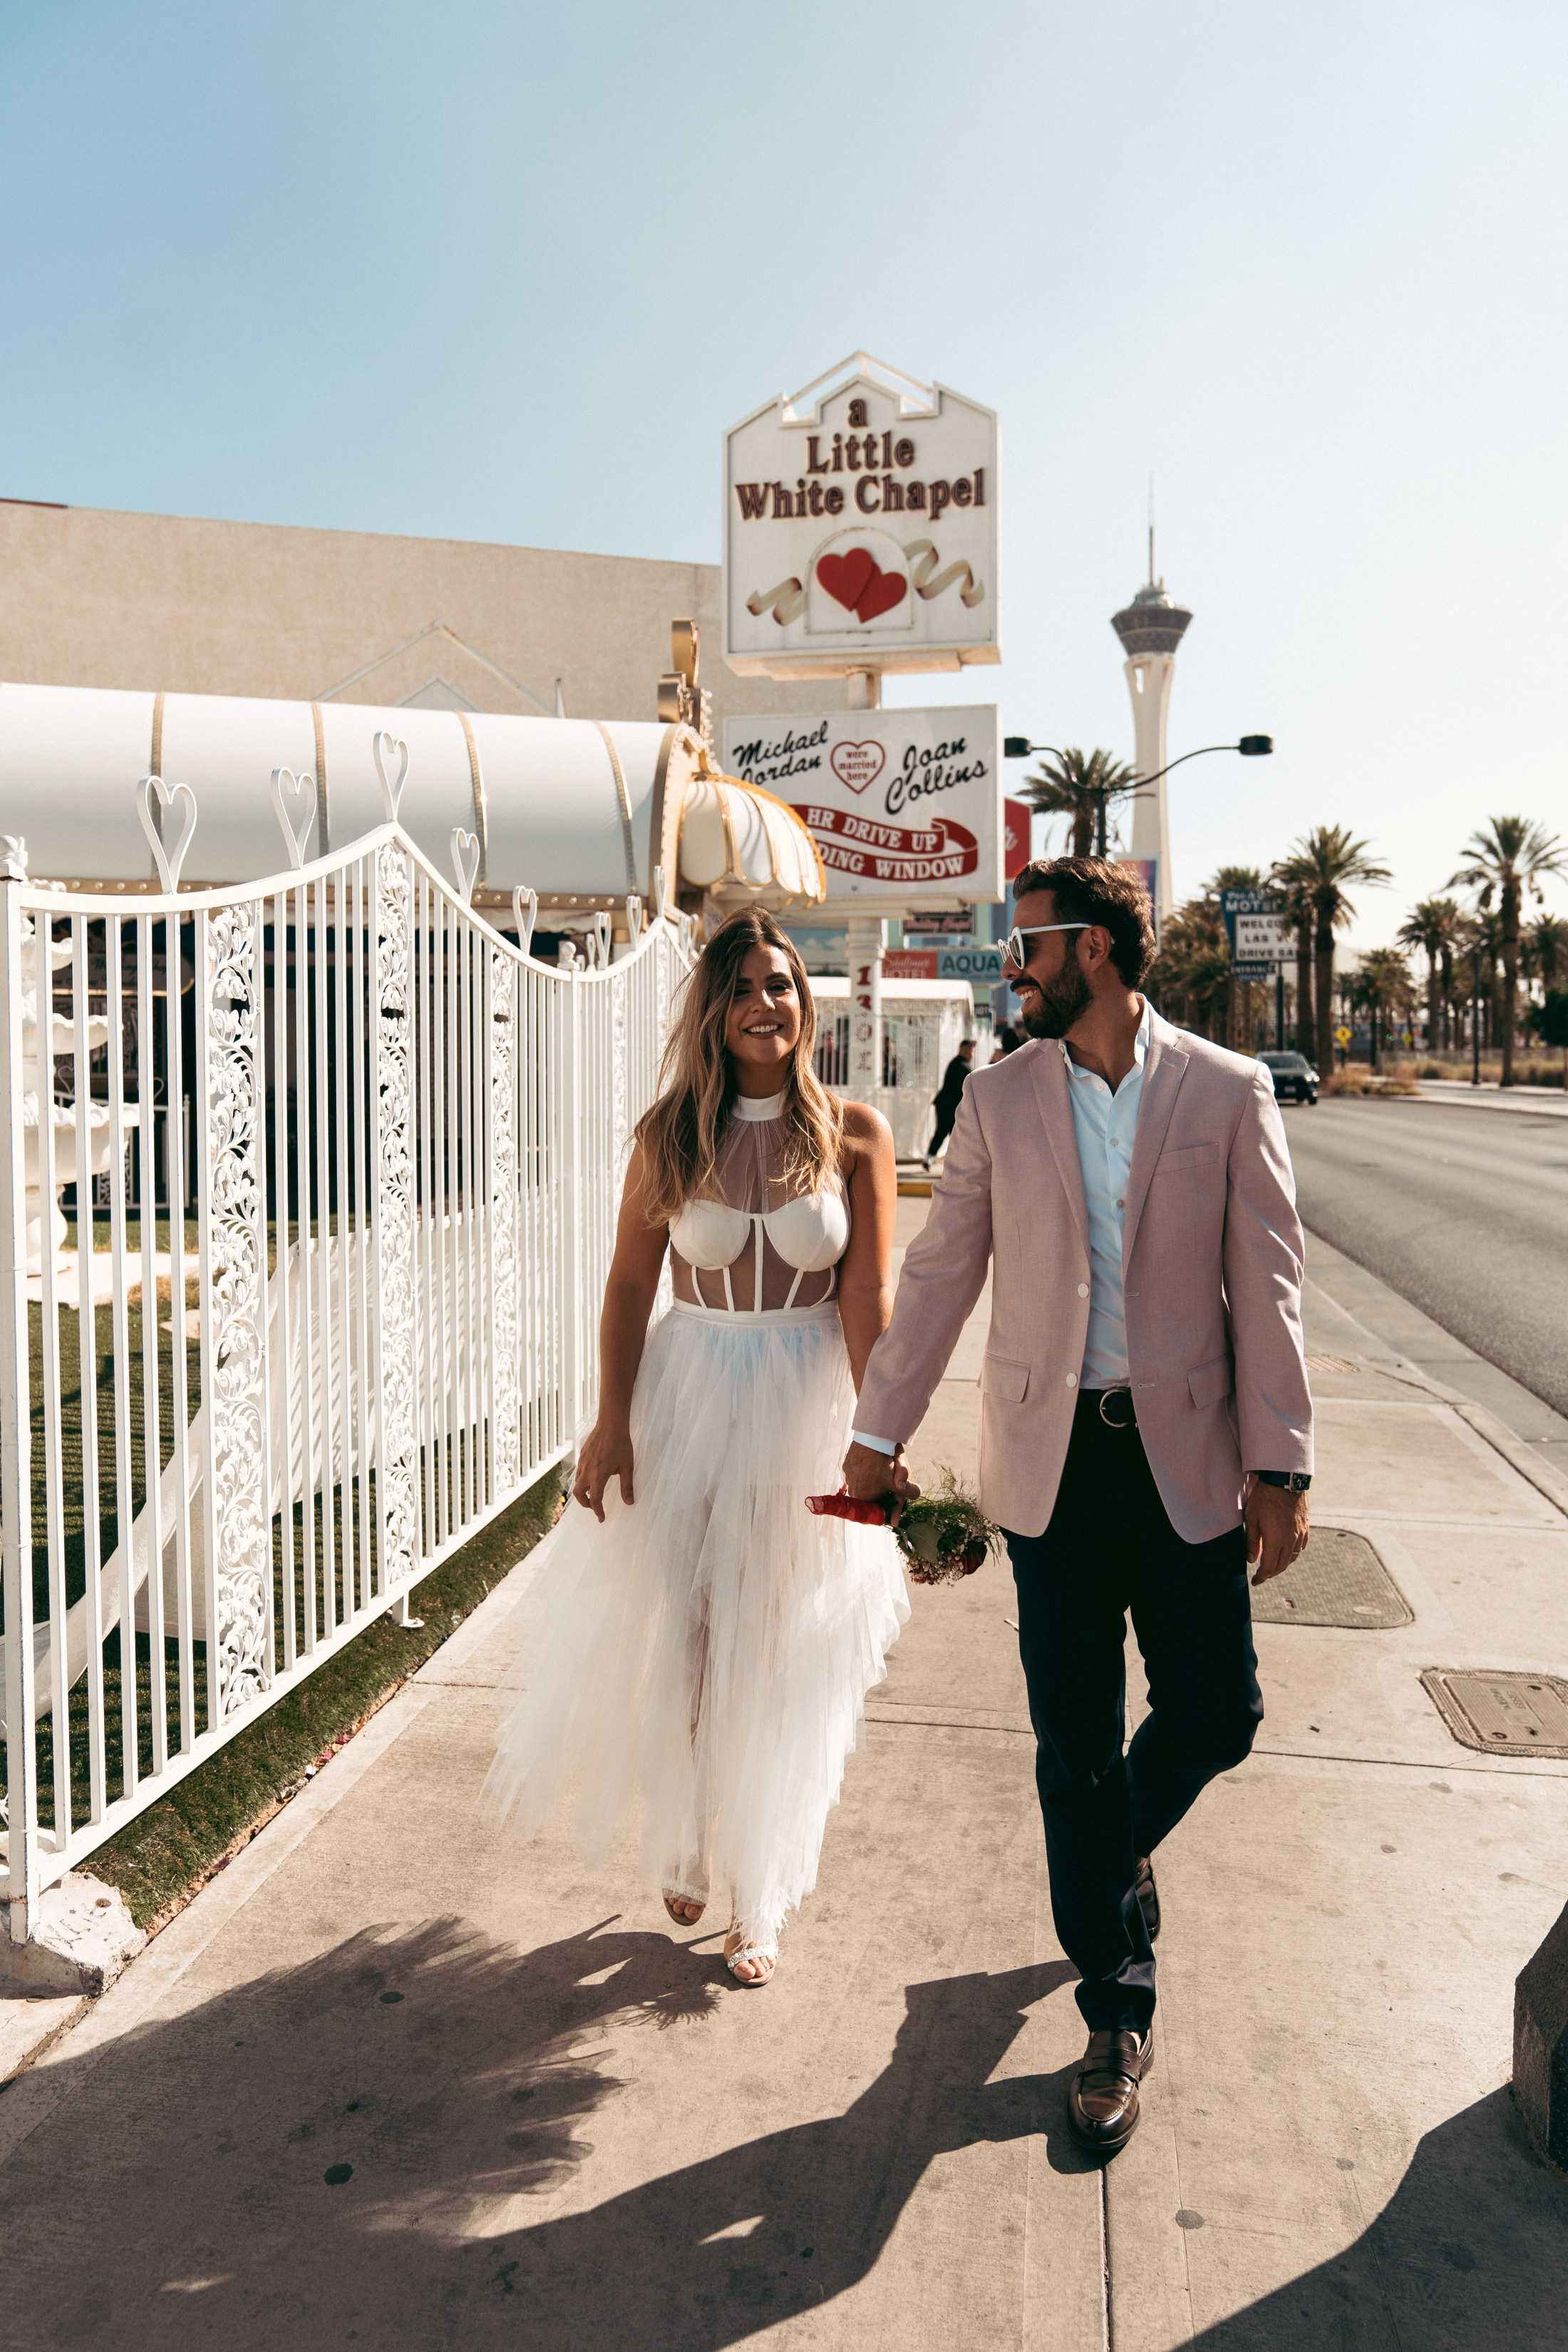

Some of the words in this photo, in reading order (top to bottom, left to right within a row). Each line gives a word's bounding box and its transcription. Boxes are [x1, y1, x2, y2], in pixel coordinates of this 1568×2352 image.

[848, 398, 868, 428] a
[806, 430, 914, 474] Little
[736, 478, 845, 520] White
[855, 467, 986, 520] Chapel
[732, 720, 829, 768] Michael
[845, 751, 869, 759] were
[838, 758, 877, 770] married
[902, 736, 967, 783] Joan
[847, 771, 869, 780] here
[884, 758, 989, 815] Collins
[806, 808, 835, 830] HR
[842, 815, 902, 849] DRIVE
[911, 831, 938, 852] UP
[819, 842, 865, 873] DING
[875, 855, 965, 880] WINDOW
[1240, 919, 1284, 929] WELCO
[1244, 934, 1269, 943] LAS
[942, 955, 1000, 974] AQUA
[1239, 949, 1274, 958] DRIVE
